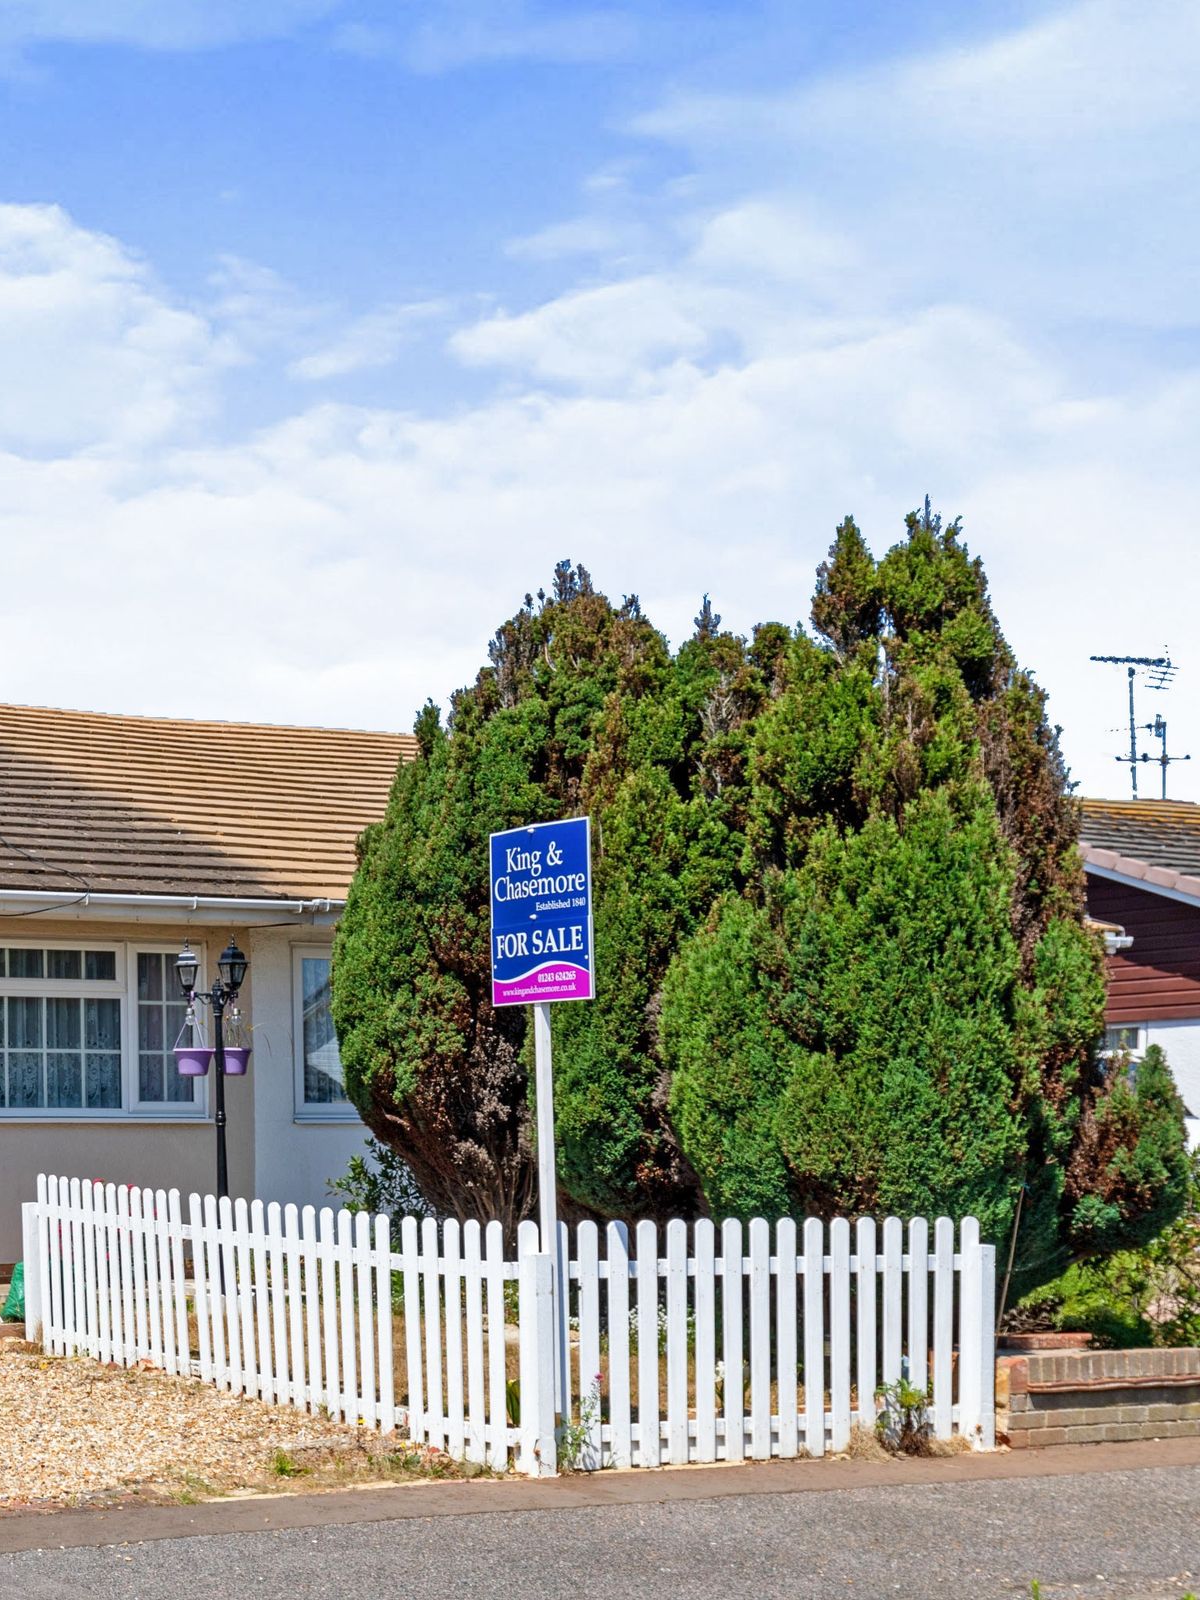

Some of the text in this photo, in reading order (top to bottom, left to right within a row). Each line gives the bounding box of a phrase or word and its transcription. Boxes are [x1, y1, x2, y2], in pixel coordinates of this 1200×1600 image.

[506, 841, 563, 877] King &
[495, 873, 585, 902] Chasemore
[536, 899, 570, 911] Established
[496, 926, 583, 959] FOR SALE
